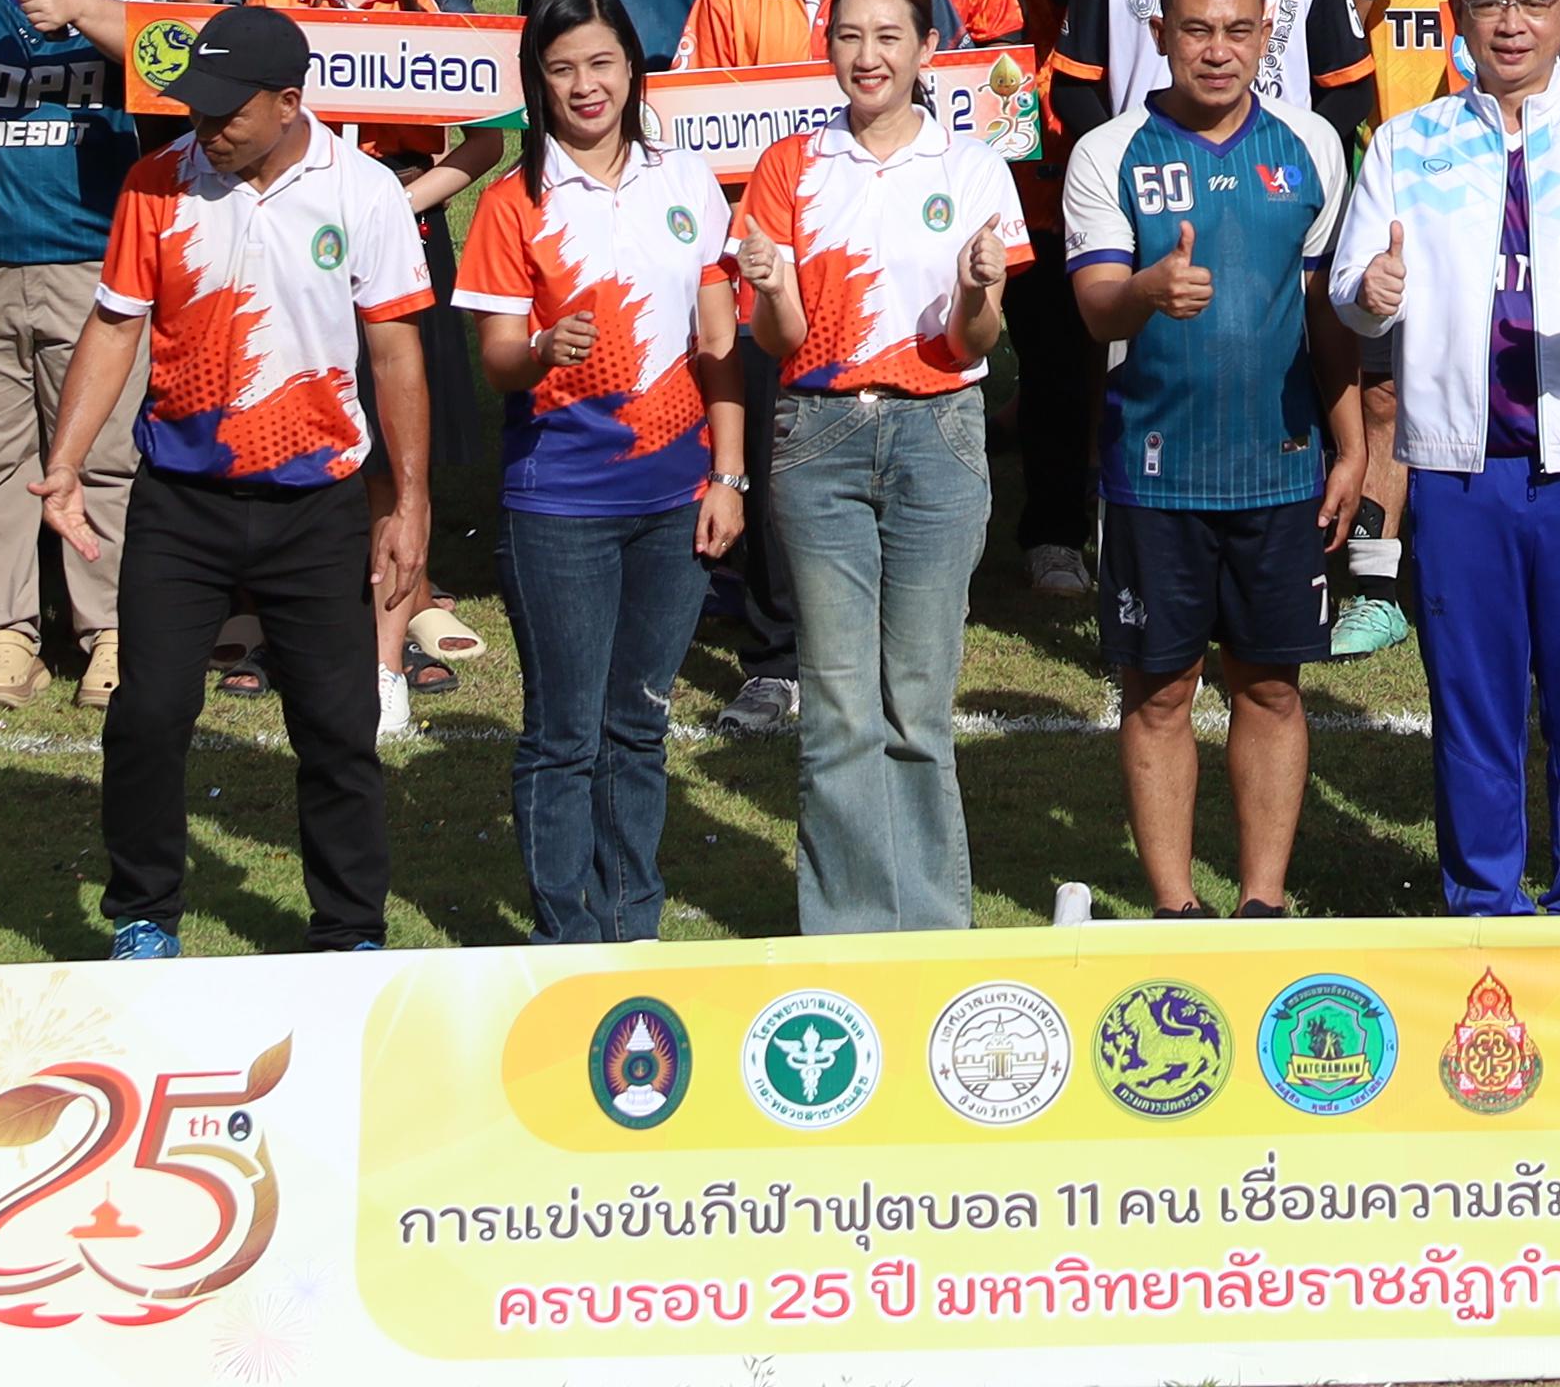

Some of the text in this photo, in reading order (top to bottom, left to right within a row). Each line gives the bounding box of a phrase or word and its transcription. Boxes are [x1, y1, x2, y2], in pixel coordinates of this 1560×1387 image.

[1386, 6, 1444, 50] TA
[188, 1114, 221, 1139] th
[398, 1180, 1039, 1251] การแข่งขันกีฬาฟุตบอล
[1056, 1183, 1103, 1228] 11
[1119, 1179, 1202, 1225] คน
[498, 1278, 750, 1328] ครบรอบ
[769, 1271, 850, 1319] 25
[871, 1259, 917, 1319] ปี
